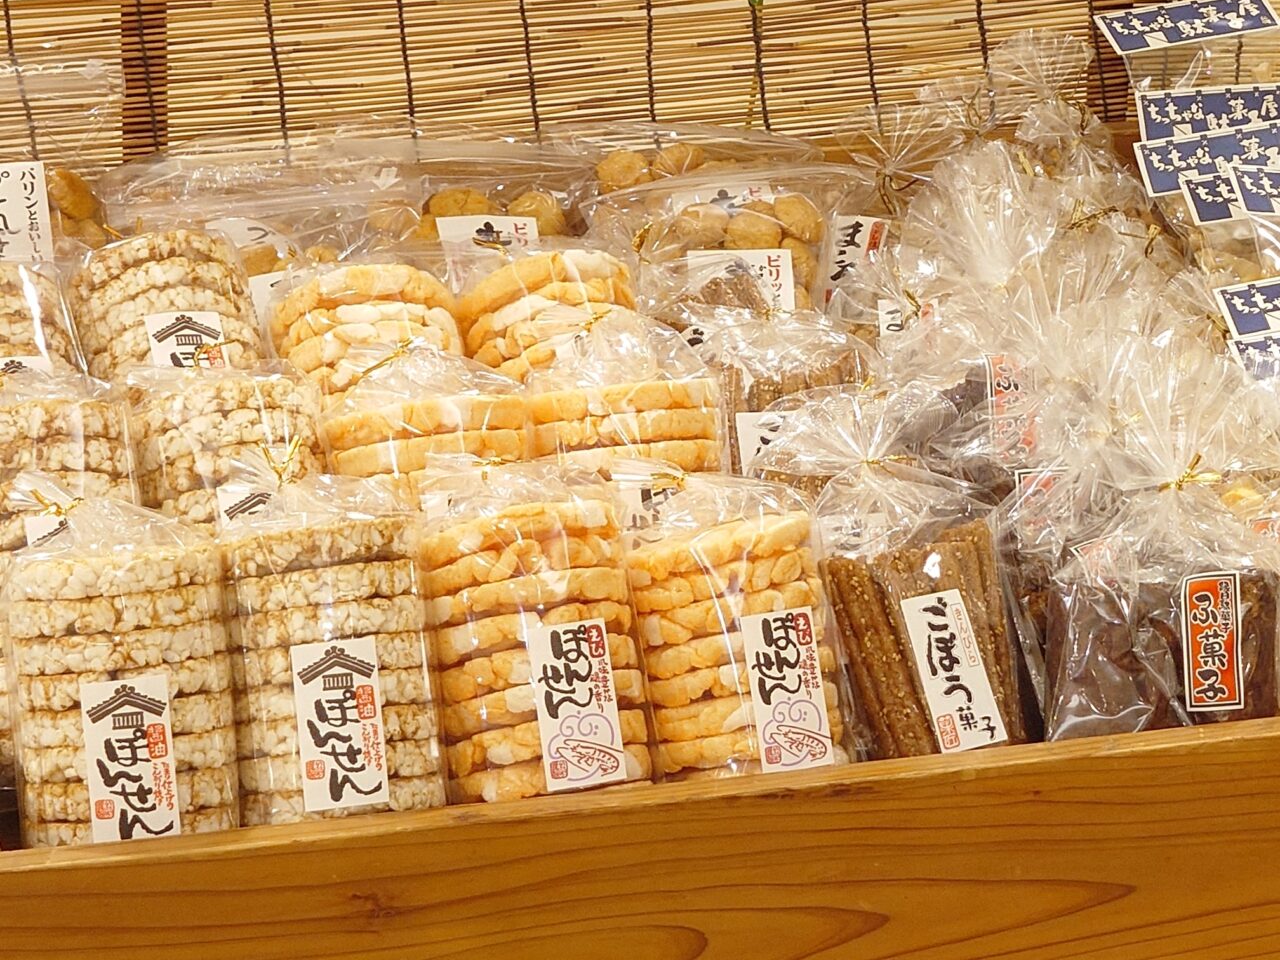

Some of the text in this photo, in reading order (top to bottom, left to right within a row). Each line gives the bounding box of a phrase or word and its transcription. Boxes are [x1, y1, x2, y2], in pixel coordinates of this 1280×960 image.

[588, 628, 605, 657] えび
[751, 612, 802, 706] ぽんせん
[795, 615, 811, 644] えび
[954, 607, 977, 664] きんぴら
[1192, 591, 1229, 701] ふ菓子
[356, 685, 376, 720] 醤油
[538, 624, 593, 720] ぽんせん
[147, 724, 168, 759] 醤油
[306, 689, 383, 803] ぽんせん
[96, 728, 174, 840] ぽんせん
